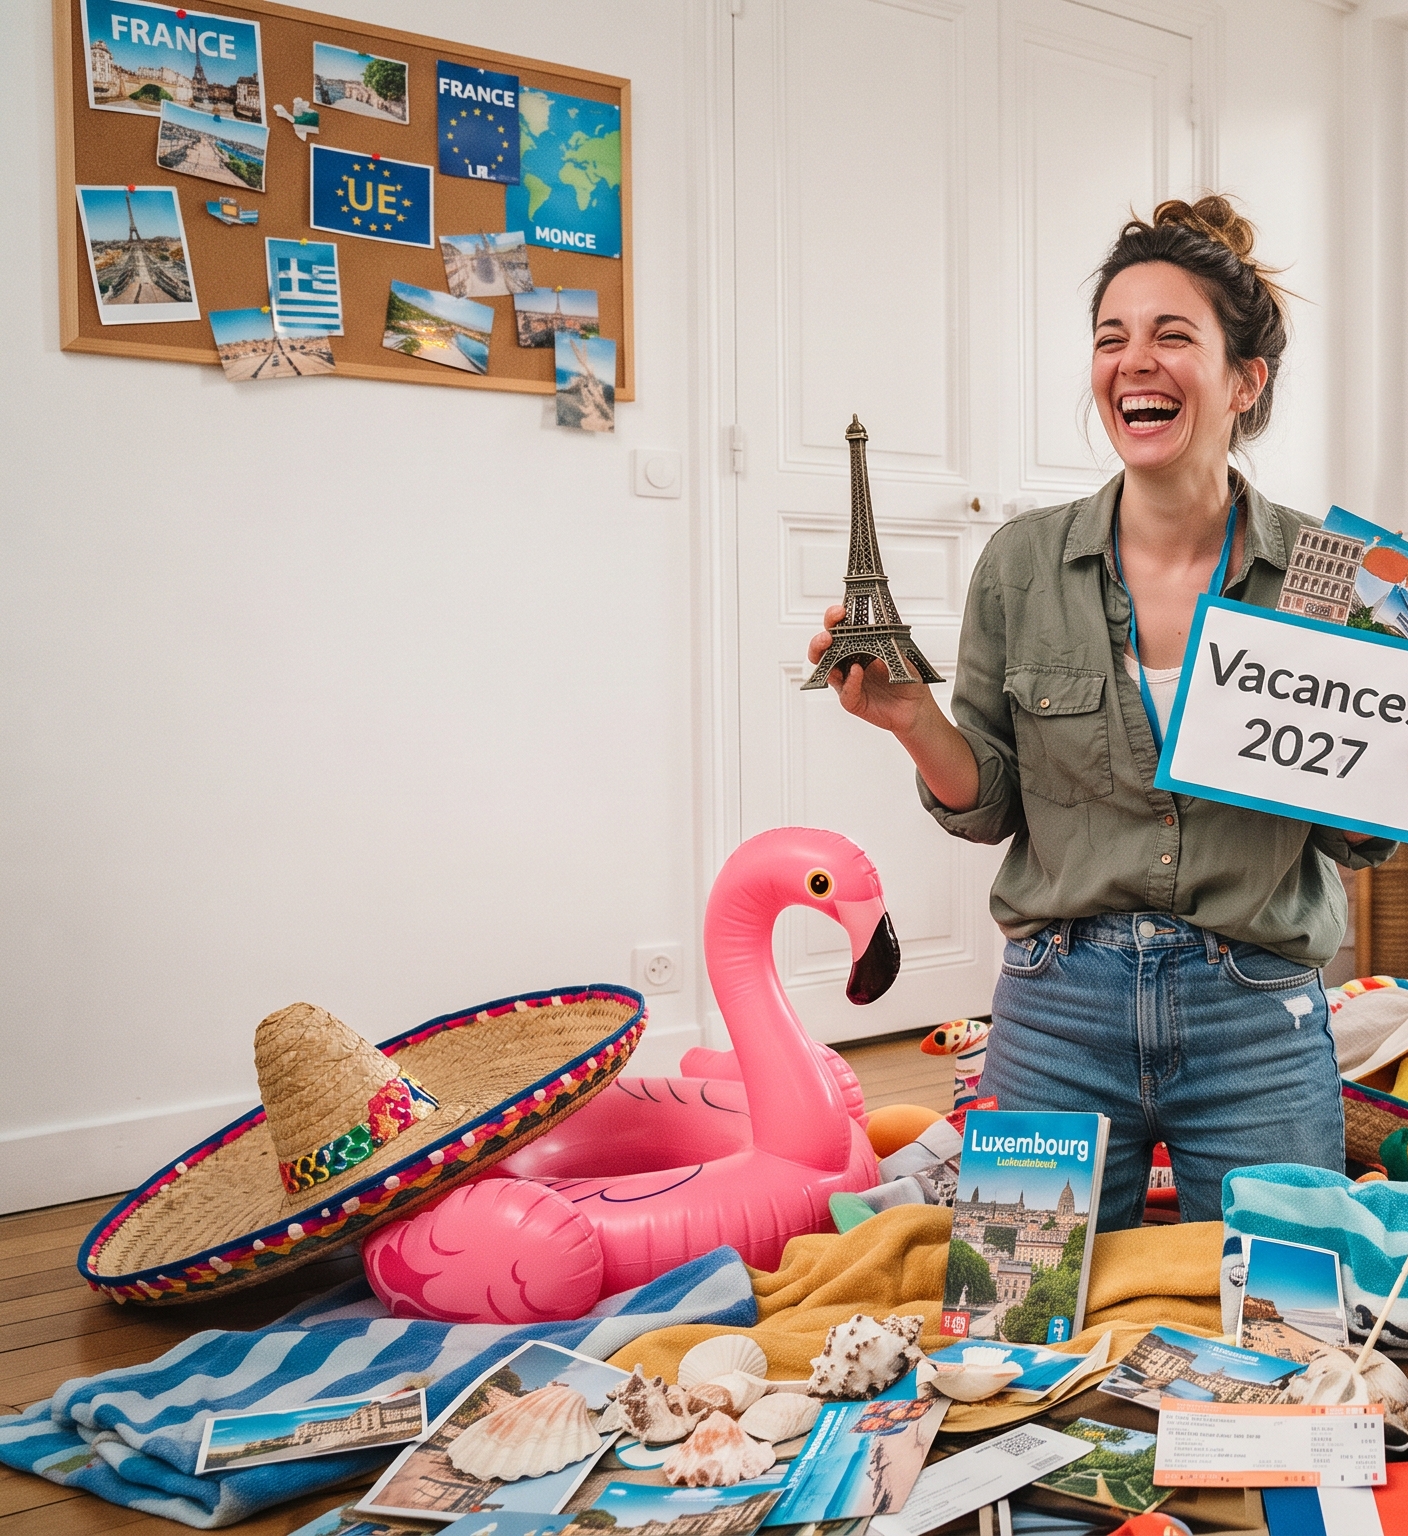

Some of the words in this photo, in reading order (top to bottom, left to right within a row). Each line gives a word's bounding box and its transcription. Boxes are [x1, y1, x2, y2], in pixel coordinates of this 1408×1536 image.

[111, 14, 237, 61] FRANCE
[439, 77, 516, 109] FRANCE
[348, 178, 397, 215] UE
[535, 225, 597, 250] MONCE
[1237, 717, 1369, 779] 2027
[971, 1128, 1089, 1162] Luxembourg
